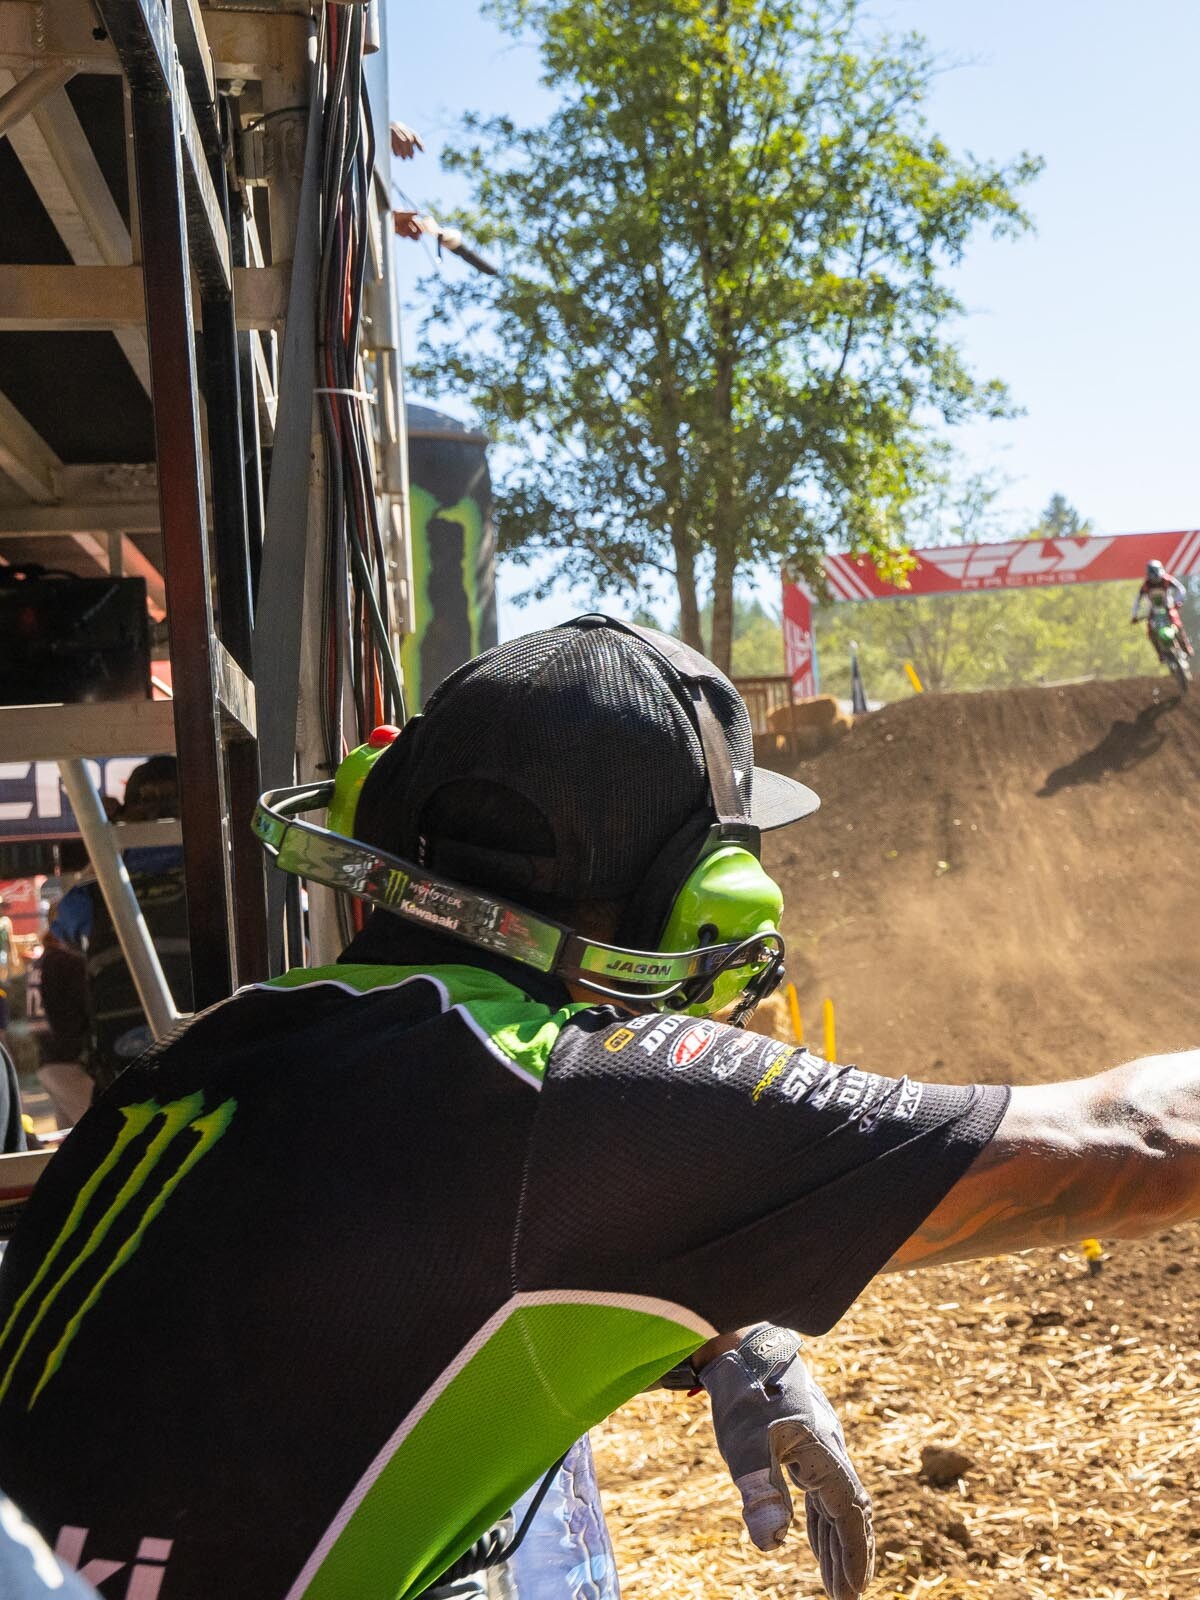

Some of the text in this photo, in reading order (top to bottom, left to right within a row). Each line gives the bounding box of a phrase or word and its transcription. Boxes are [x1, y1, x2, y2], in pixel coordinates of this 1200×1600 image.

[915, 538, 1115, 580] FLY
[961, 572, 1075, 589] RACING
[400, 898, 460, 931] Kawasaki
[606, 958, 673, 976] JASON
